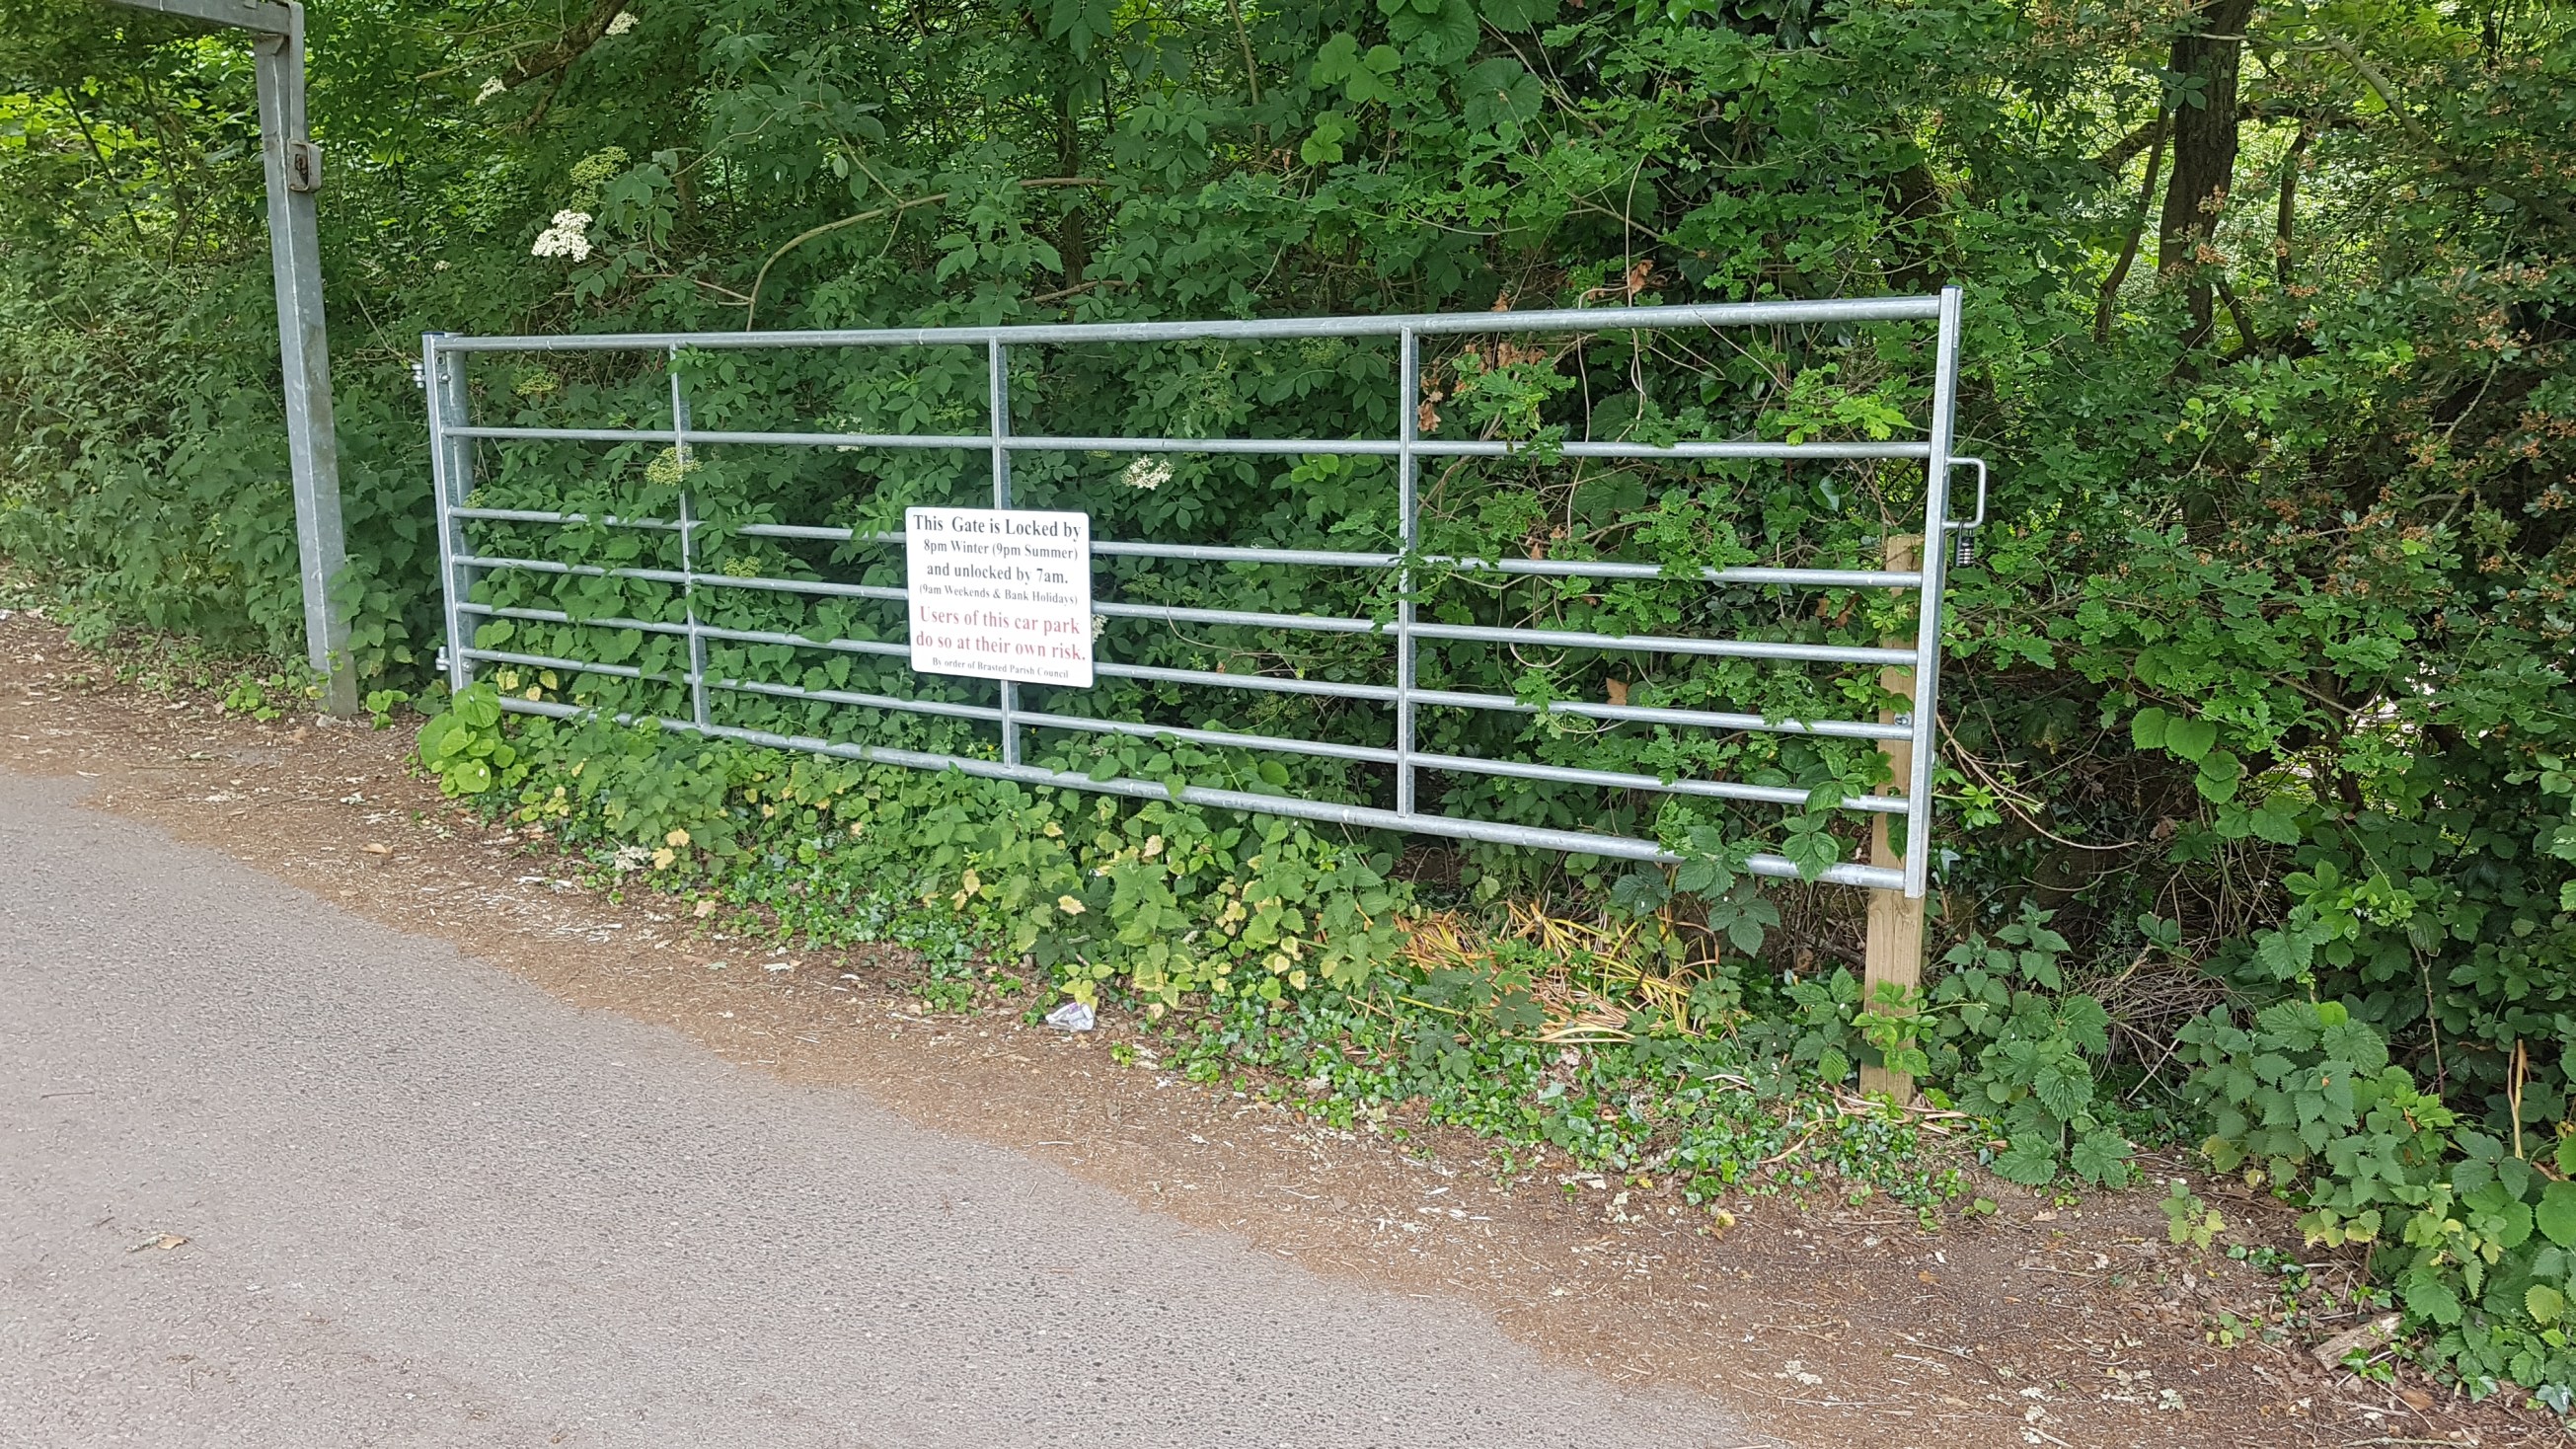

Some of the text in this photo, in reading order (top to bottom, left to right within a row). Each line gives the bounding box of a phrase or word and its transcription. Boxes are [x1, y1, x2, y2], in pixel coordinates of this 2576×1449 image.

[914, 514, 1081, 542] This Gate is Locked by
[924, 539, 1078, 561] 8pm Winter (9pm Summer)
[927, 563, 1068, 584] and unlocked by 7am.
[920, 584, 1078, 606] (9am Weekends & Bank Holidays)
[920, 606, 1080, 636] Users of this car park
[917, 631, 1086, 660] do so at their own risk.
